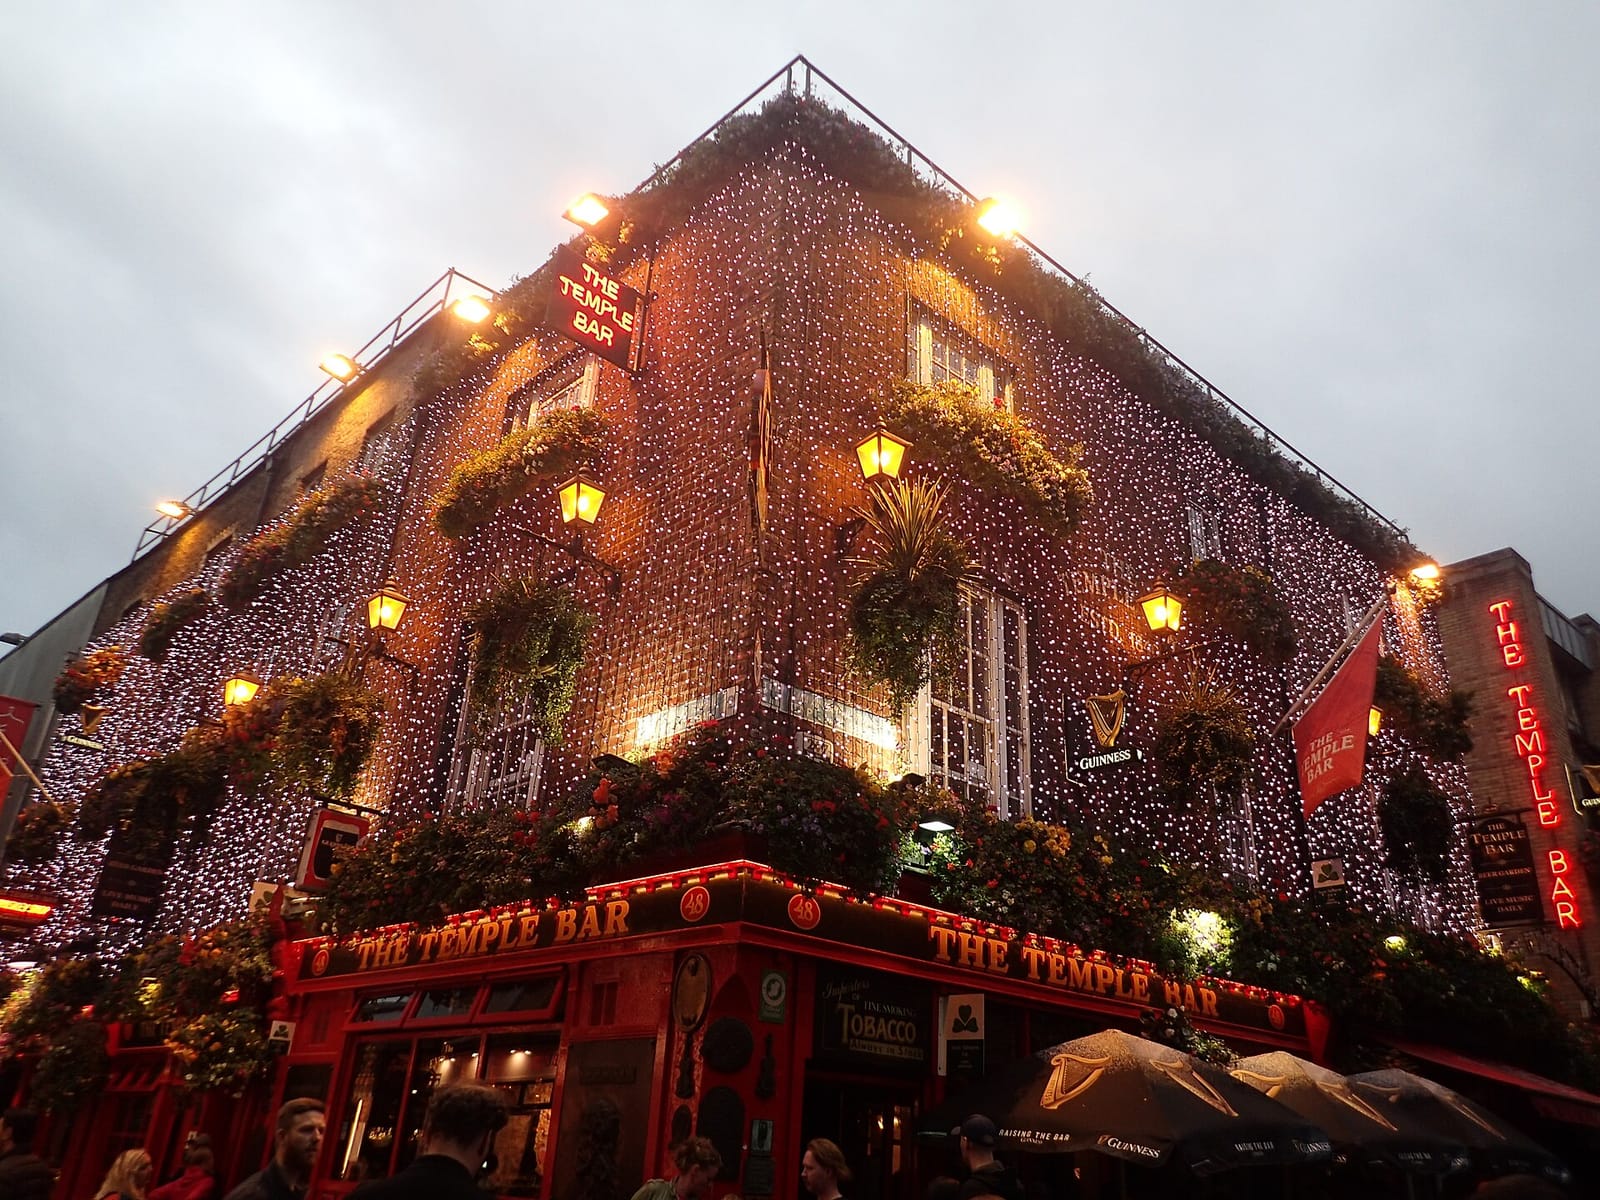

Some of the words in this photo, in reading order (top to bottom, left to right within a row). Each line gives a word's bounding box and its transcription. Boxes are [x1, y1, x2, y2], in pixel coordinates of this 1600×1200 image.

[582, 263, 620, 300] THE
[559, 275, 634, 332] TEMPLE
[573, 311, 614, 346] BAR
[1309, 731, 1334, 752] THE
[1079, 748, 1132, 771] GUINNESS
[1306, 757, 1334, 784] BAR
[1489, 601, 1526, 666] THE
[1508, 686, 1558, 826] TEMPLE
[1548, 851, 1581, 928] BAR
[1471, 829, 1526, 845] TEMPLE
[1487, 822, 1505, 832] THE
[1484, 843, 1515, 855] BAR
[685, 891, 705, 916] 48
[793, 898, 814, 920] 48
[357, 936, 410, 972] THE
[418, 914, 540, 961] TEMPLE
[553, 899, 631, 942] BAR
[928, 925, 1010, 975] THE
[1021, 945, 1151, 1003] TEMPLE
[1163, 979, 1220, 1018] BAR
[834, 1002, 917, 1044] TOBACCO
[999, 1128, 1032, 1140] RAISING
[1034, 1131, 1050, 1141] THE
[1052, 1132, 1070, 1142] BAR
[1107, 1136, 1161, 1159] GUINNESS
